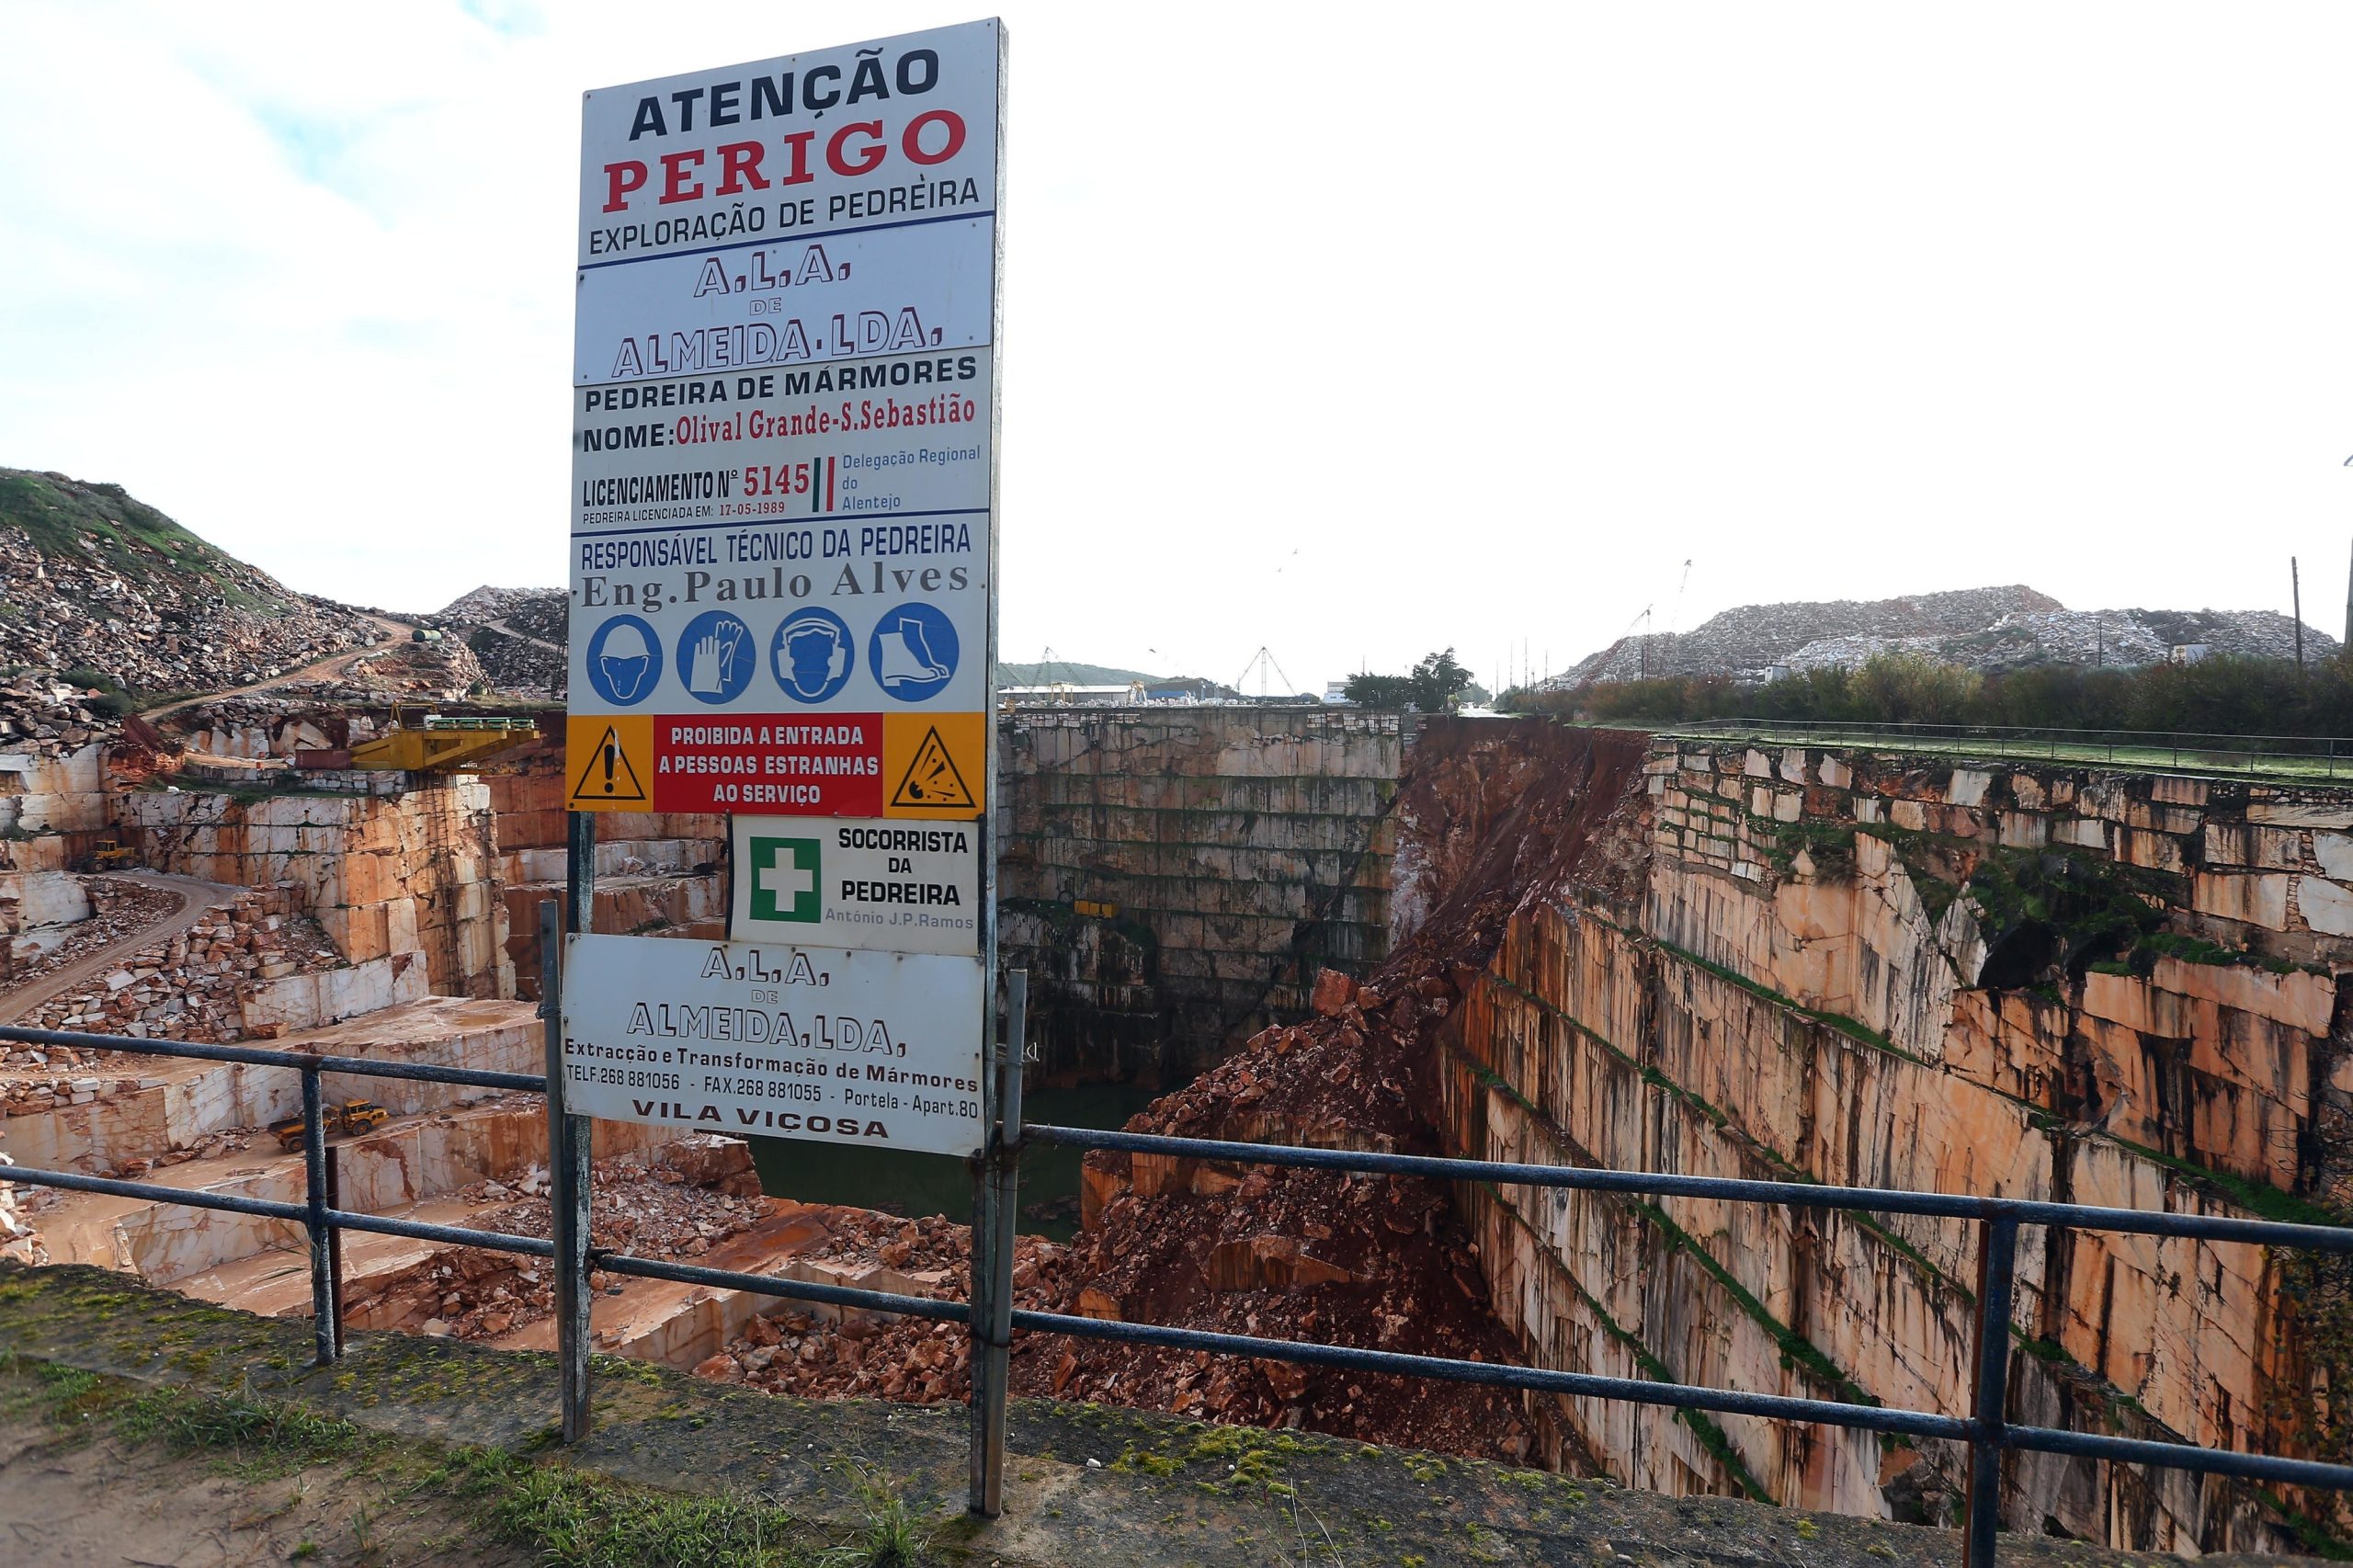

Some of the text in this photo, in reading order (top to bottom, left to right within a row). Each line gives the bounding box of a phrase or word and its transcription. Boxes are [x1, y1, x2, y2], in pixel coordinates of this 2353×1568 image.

[628, 47, 939, 142] ATENÇÃO
[602, 109, 967, 213] PERIGO
[590, 177, 980, 255] EXPLORAÇÃO DE PEDREIRA
[749, 297, 781, 316] DE
[585, 356, 977, 412] PEDREIRA DE MÁRMORES
[842, 445, 980, 470] Delegação Regional
[582, 470, 713, 507] LICENCIAMENTO
[743, 462, 810, 497] 5145
[842, 475, 858, 490] do
[583, 501, 785, 525] PEDREIRA LICENCIADA EM: 17-05-1989
[842, 494, 901, 510] Alentejo
[582, 523, 972, 571] RESPONSÁVEL TÉCNICO DA PEDREIRA
[832, 560, 968, 596] Alves
[671, 726, 863, 745] PROIBIDA A ENTRADA
[659, 756, 879, 776] A PESSOAS ESTRANHAS
[713, 784, 821, 807] AO SERVIÇO
[838, 827, 968, 854] SOCORRISTA
[888, 857, 912, 875] DA
[841, 881, 961, 906] PEDREIRA
[825, 907, 883, 926] António
[751, 989, 779, 1004] DE
[564, 1039, 978, 1092] Extracção e Transformação de Mármores
[628, 1069, 679, 1090] 881056
[768, 1081, 821, 1102] 881055
[845, 1088, 898, 1113] Portela
[632, 1099, 889, 1140] VILA VIÇOSA
